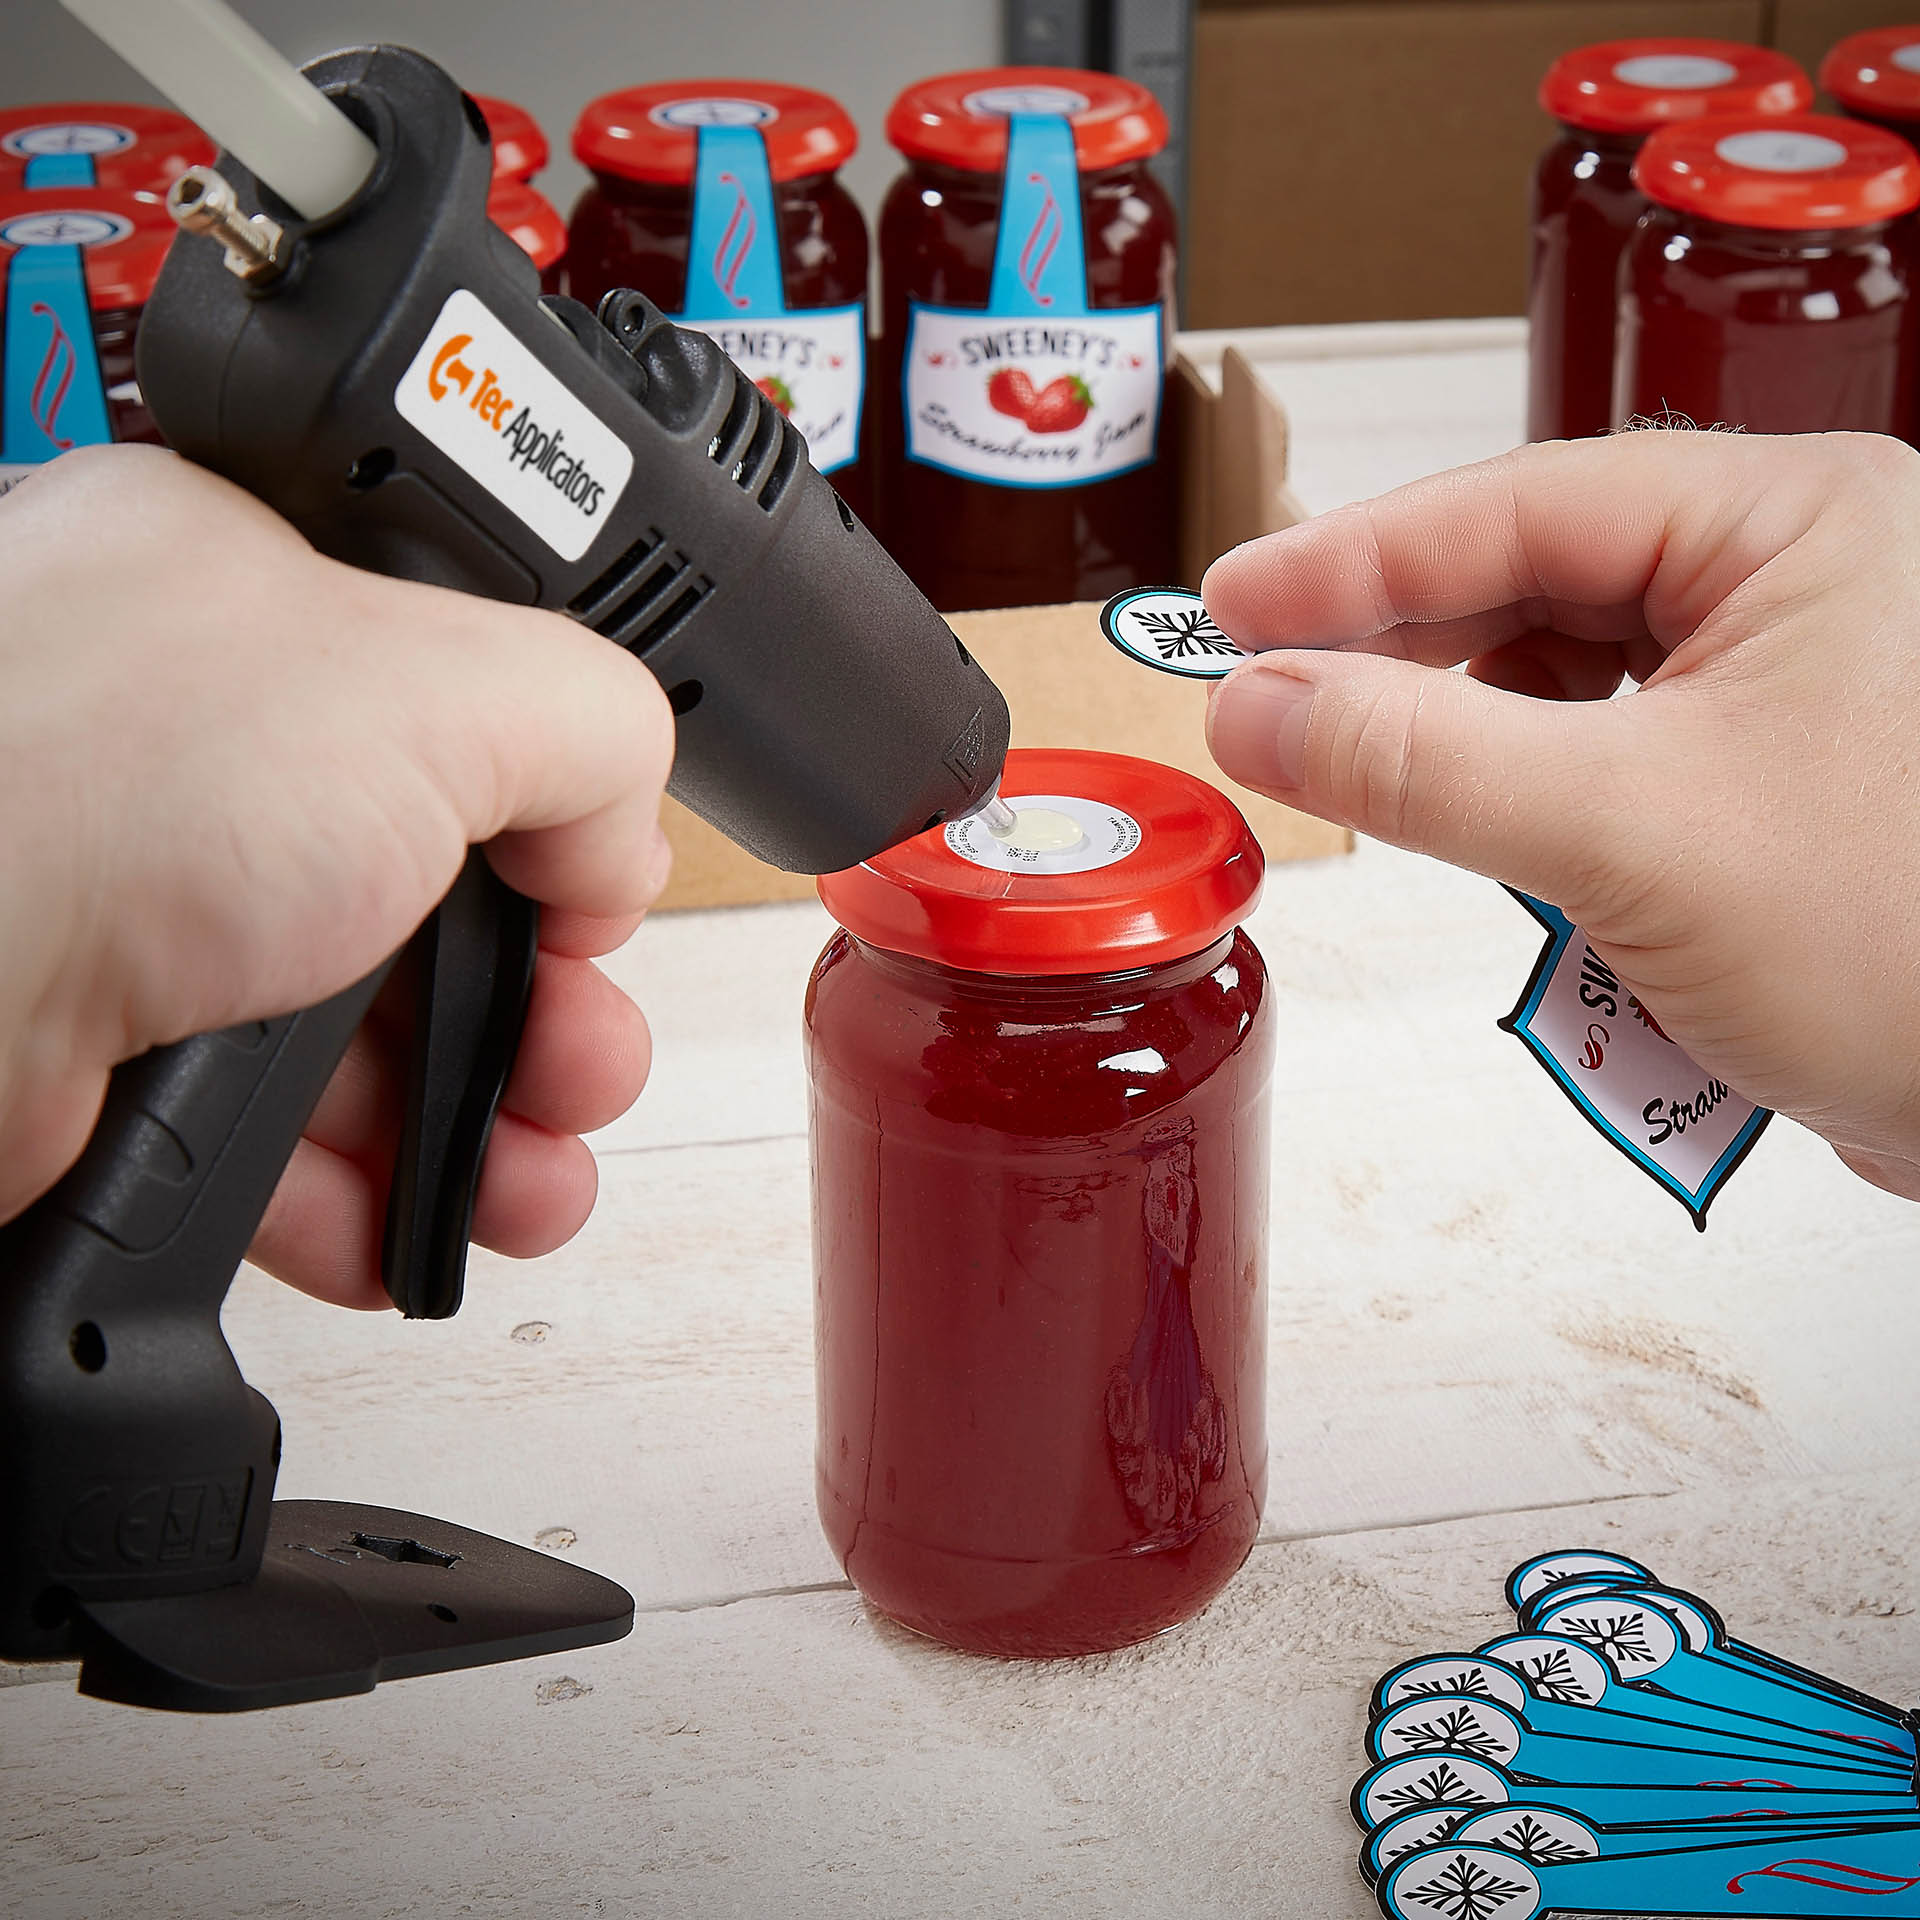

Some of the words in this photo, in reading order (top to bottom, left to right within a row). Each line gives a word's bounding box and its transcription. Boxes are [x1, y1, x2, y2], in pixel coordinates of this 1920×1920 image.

[706, 328, 817, 367] ENEY'S
[960, 327, 1116, 366] SWEENEY'S
[469, 368, 515, 432] Tec
[502, 407, 606, 516] Applicators
[1107, 816, 1126, 834] TAMPER
[1121, 817, 1138, 834] SAFETY
[1121, 834, 1139, 853] BUTTON
